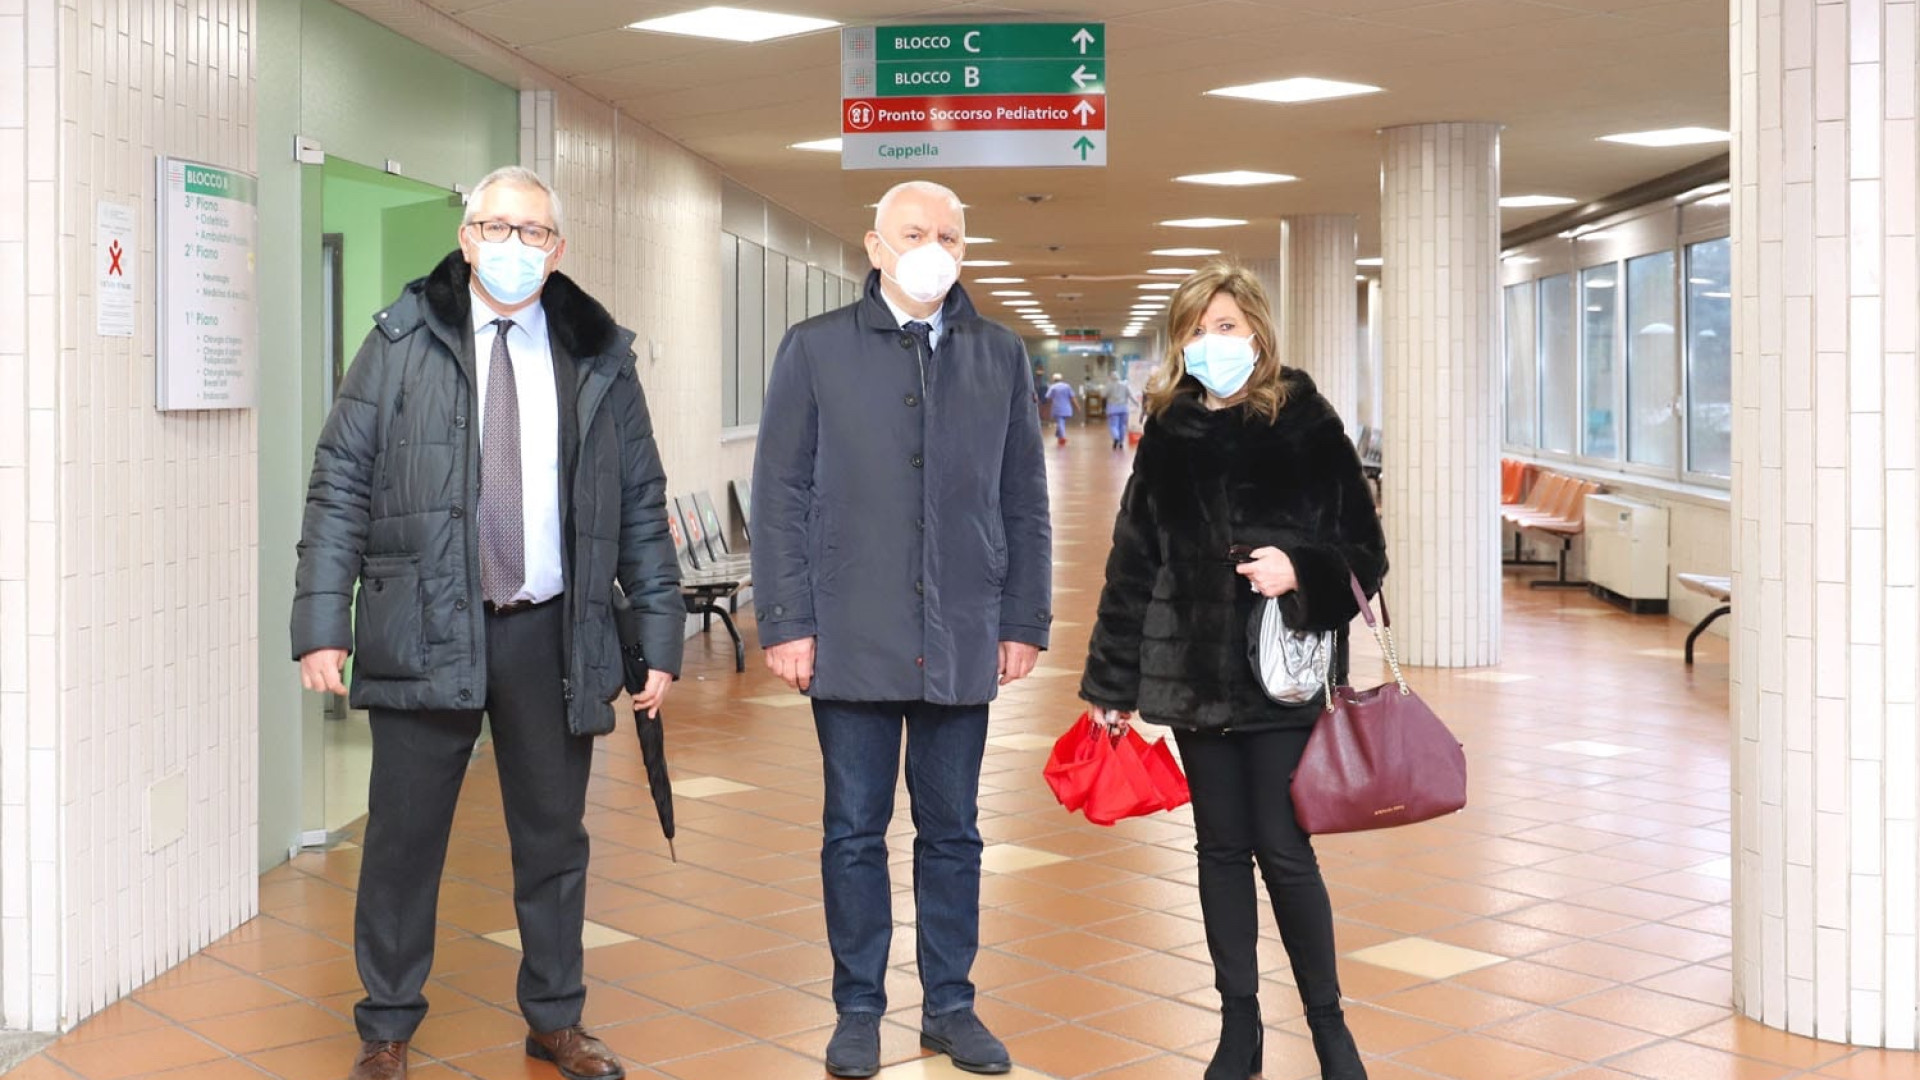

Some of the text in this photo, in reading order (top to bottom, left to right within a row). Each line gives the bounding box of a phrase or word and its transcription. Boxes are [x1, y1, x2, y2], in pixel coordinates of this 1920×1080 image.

[895, 31, 981, 53] BLOCCO C
[895, 66, 981, 88] BLOCCO B
[878, 106, 1069, 121] Pronto Soccorso Pediatrico
[878, 143, 939, 160] Cappella
[187, 170, 223, 189] BLOCCO
[196, 196, 219, 212] Piano
[196, 244, 219, 260] Piano
[196, 312, 219, 326] Piano
